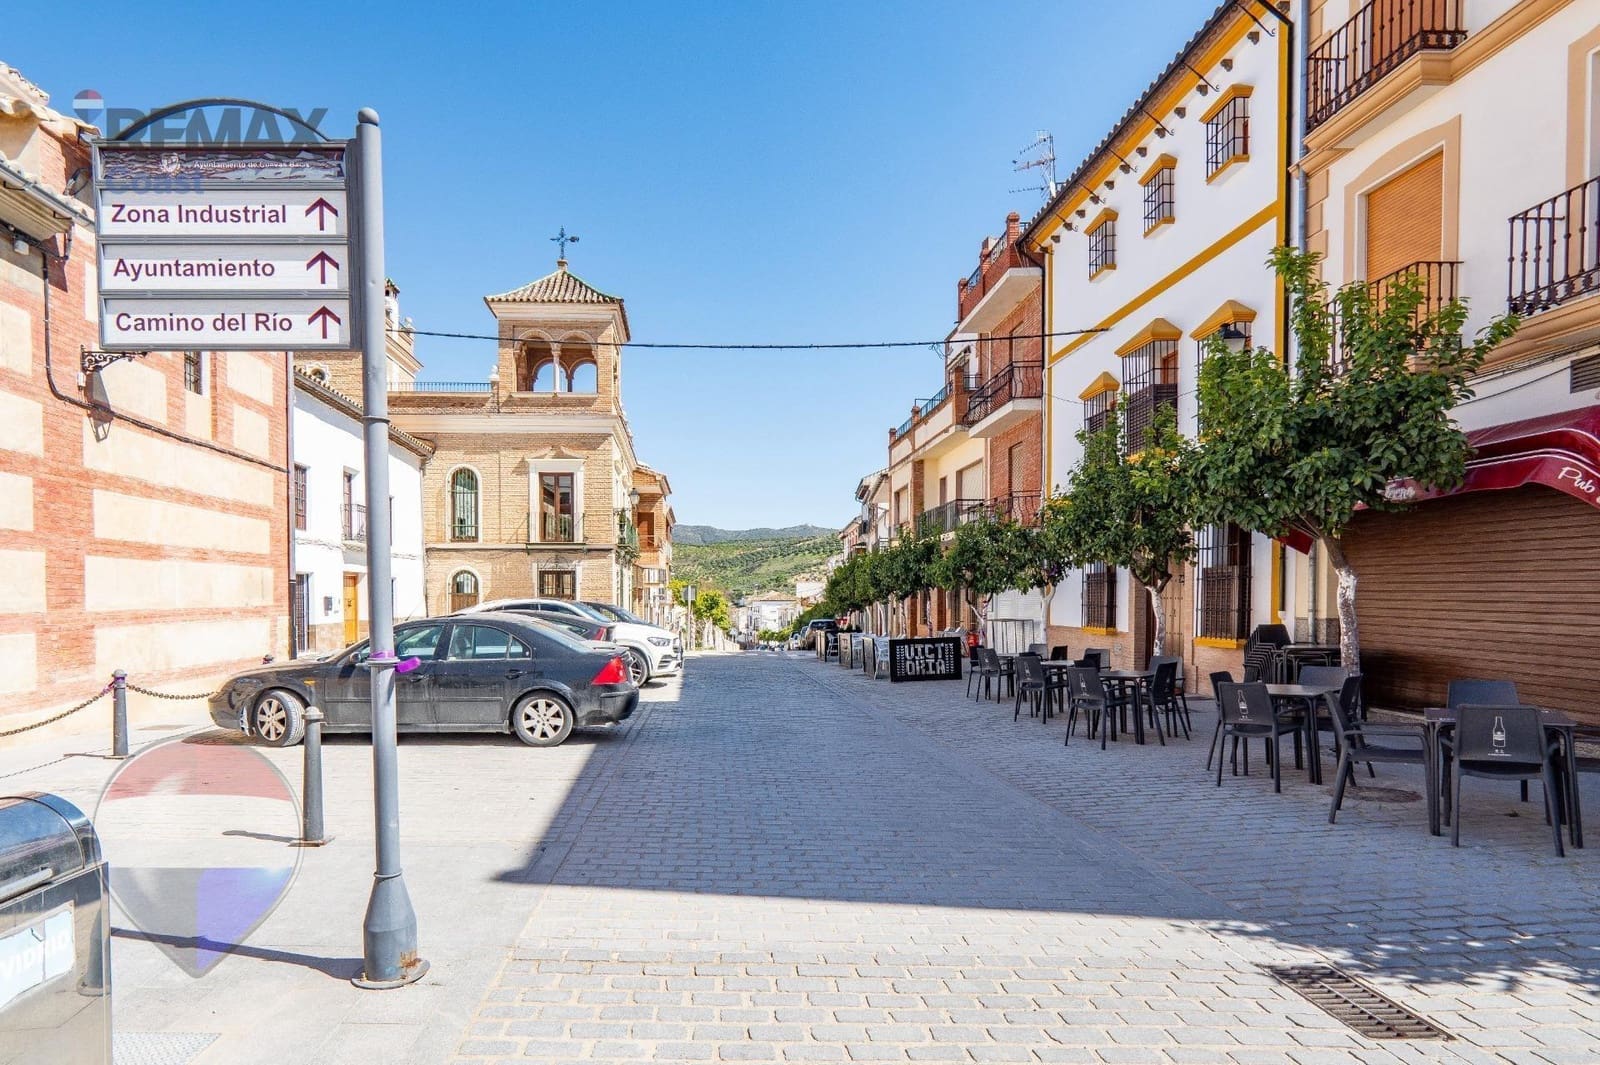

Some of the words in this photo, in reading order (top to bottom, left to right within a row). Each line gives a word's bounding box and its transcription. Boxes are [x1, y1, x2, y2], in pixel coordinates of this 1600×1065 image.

[194, 160, 245, 170] Ayuntamiento
[111, 204, 170, 224] Zona
[178, 204, 287, 224] Industrial
[113, 258, 276, 282] Ayuntamiento
[115, 312, 205, 333] Camino
[212, 312, 246, 333] del
[255, 312, 293, 333] Río
[1557, 466, 1596, 494] Pub
